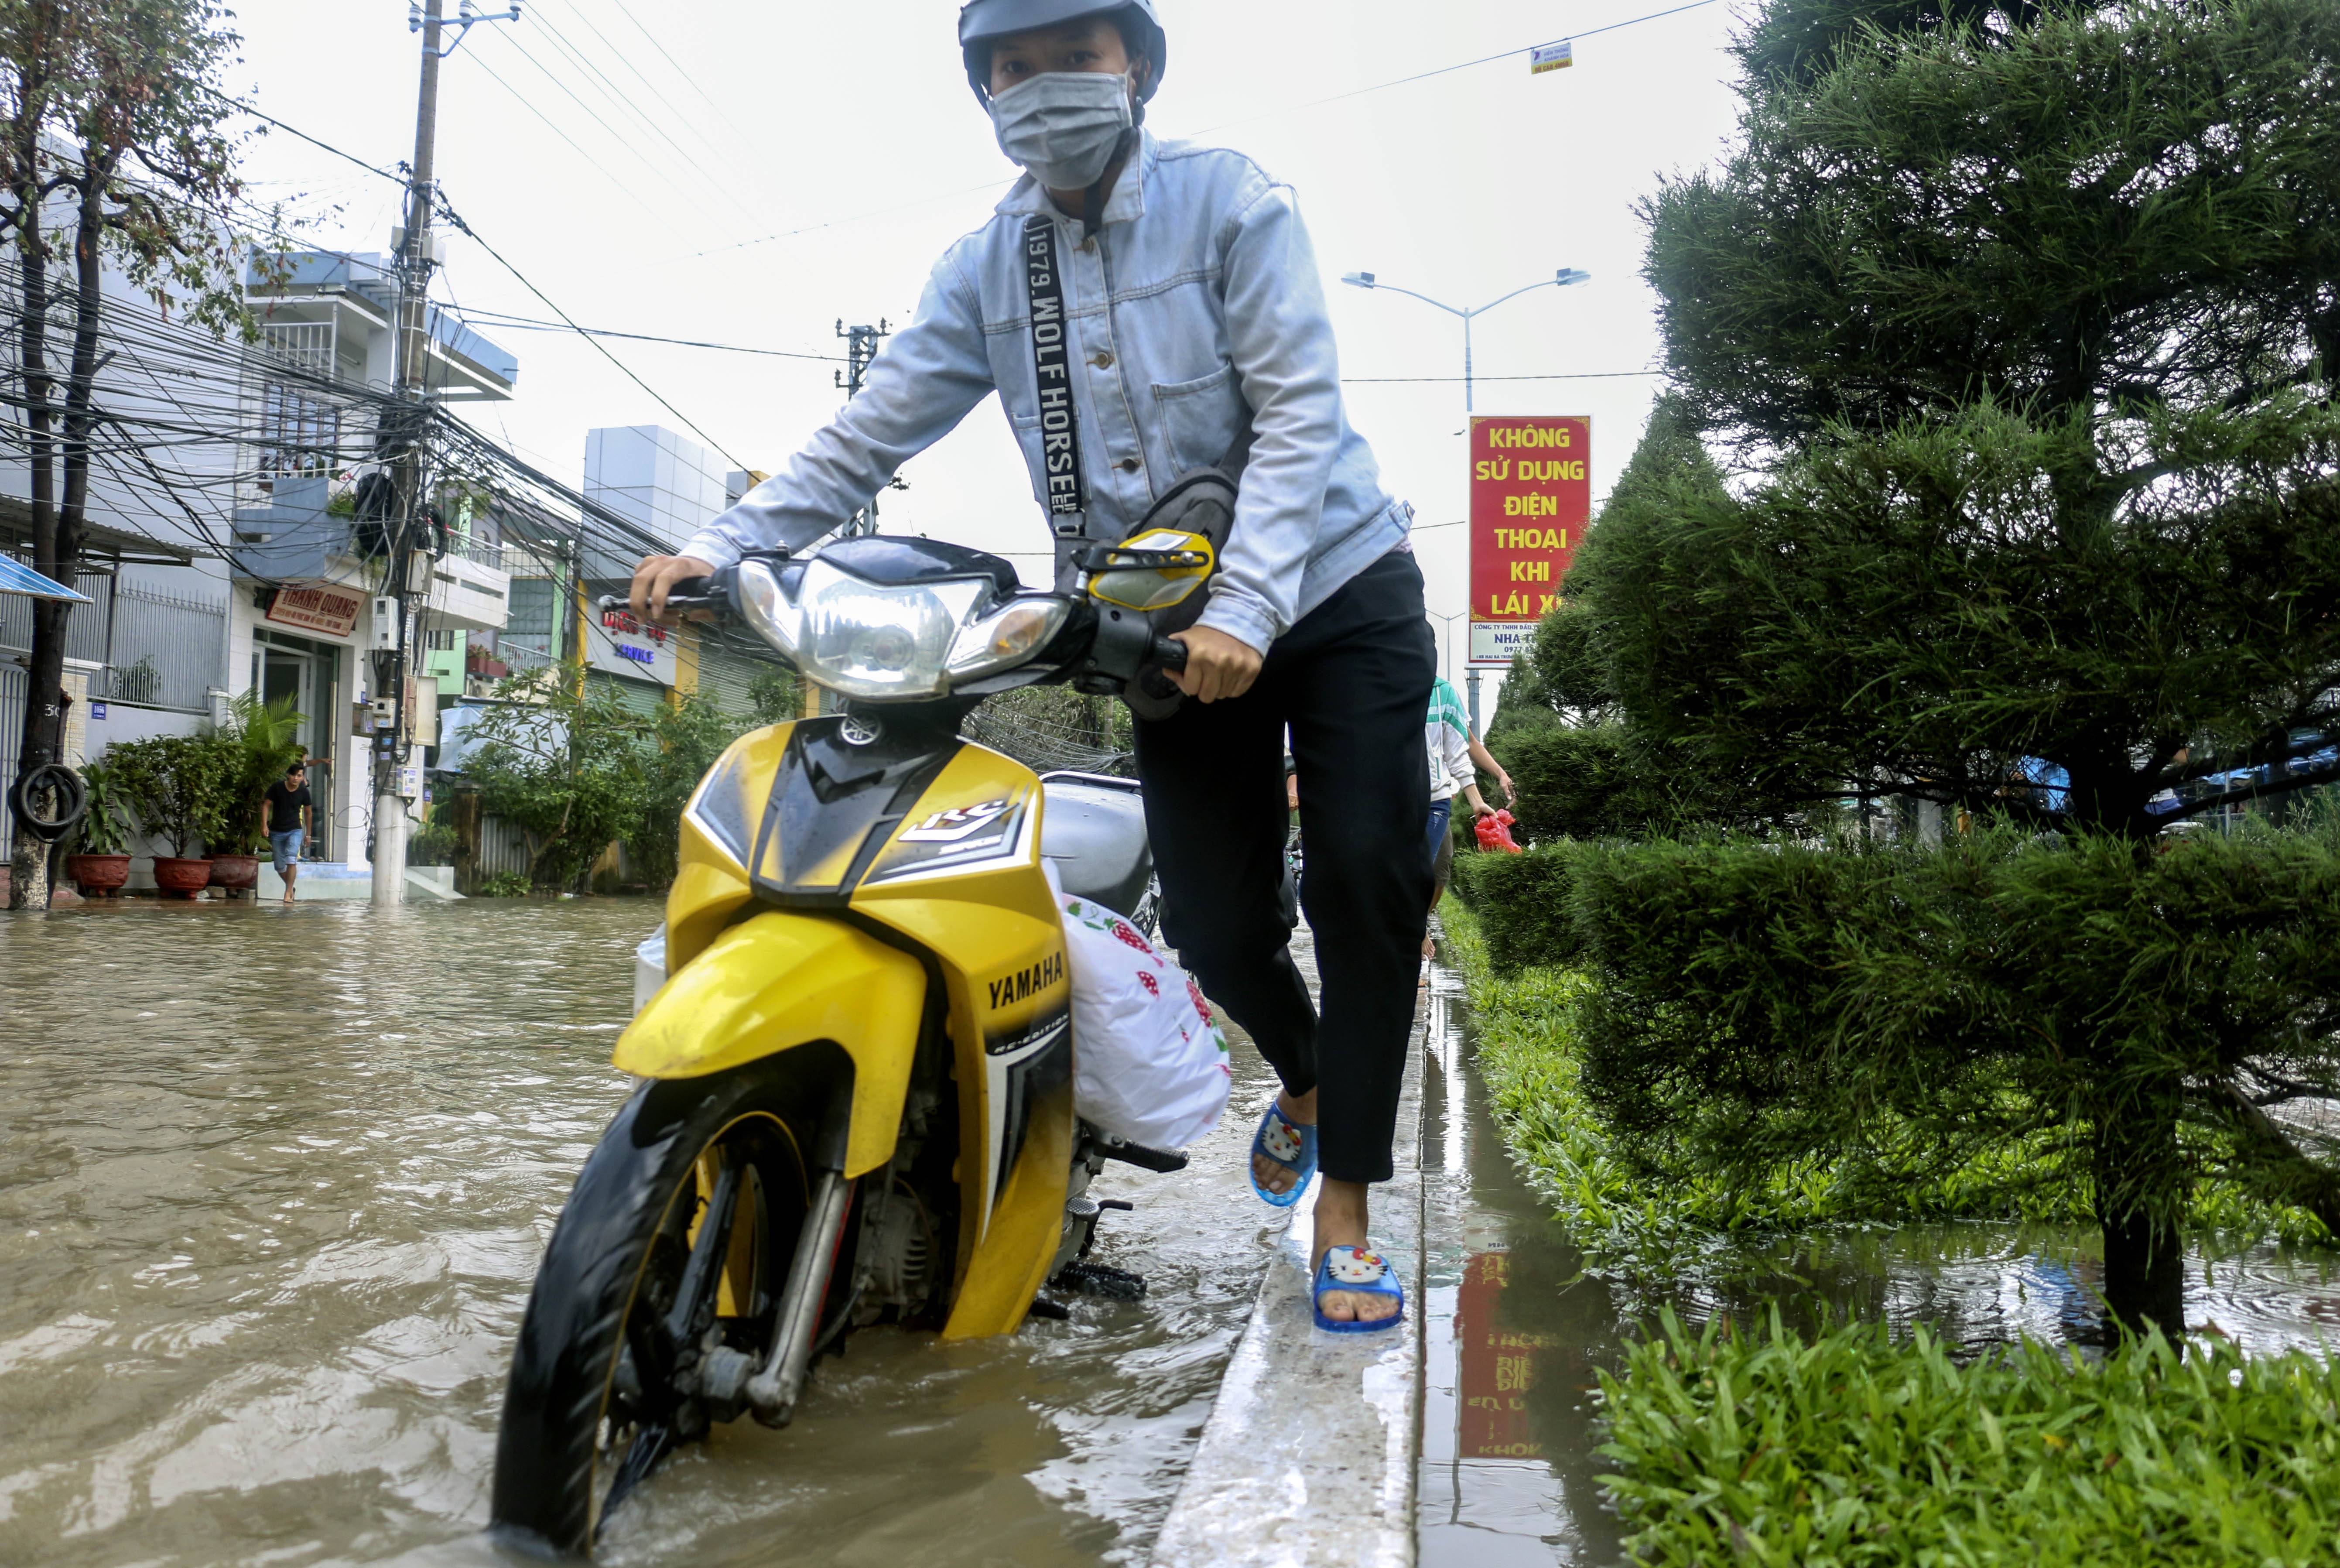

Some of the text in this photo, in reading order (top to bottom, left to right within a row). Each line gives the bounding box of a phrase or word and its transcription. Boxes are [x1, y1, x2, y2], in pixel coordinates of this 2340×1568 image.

[1040, 387, 1075, 493] HORSE
[1489, 424, 1570, 448] KHÔNG
[1476, 455, 1584, 485] SỬ DỤNG
[1503, 492, 1557, 520] ĐIỆN
[1494, 528, 1566, 553] THOẠI
[1511, 561, 1549, 581] KHI
[320, 593, 358, 618] QUANG
[1492, 590, 1529, 614] LÁI
[1494, 634, 1520, 644] NHA
[989, 951, 1063, 1010] YAMAHA
